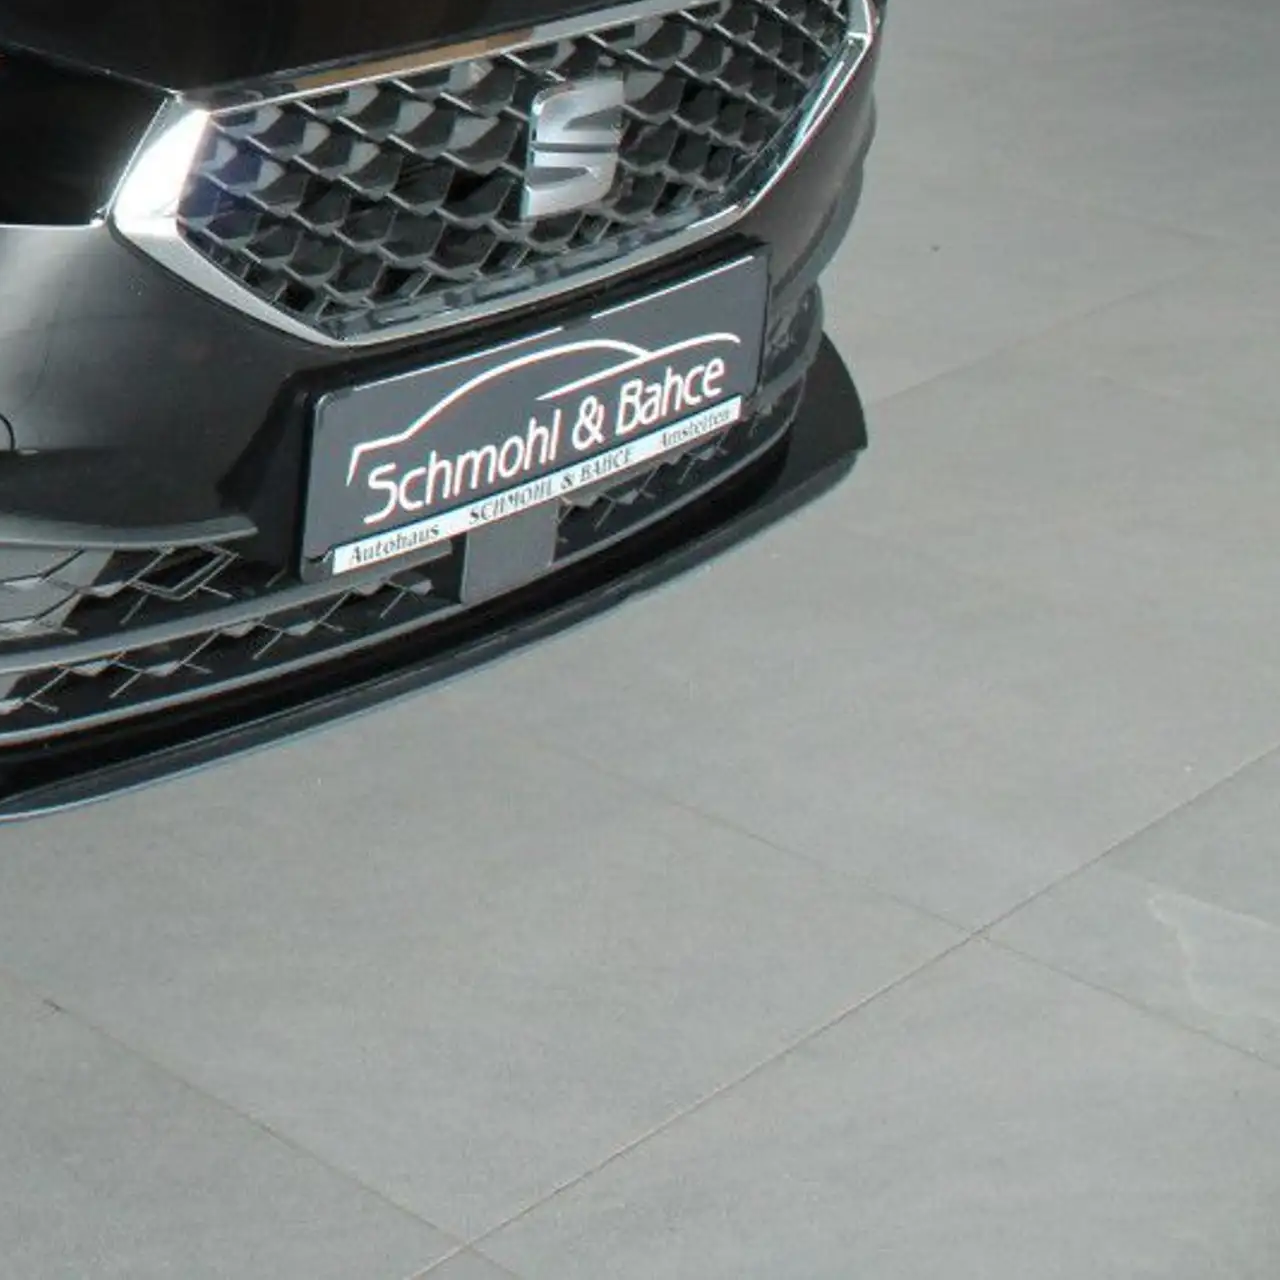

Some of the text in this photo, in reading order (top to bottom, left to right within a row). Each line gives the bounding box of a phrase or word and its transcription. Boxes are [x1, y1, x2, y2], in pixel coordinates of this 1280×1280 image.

[363, 357, 725, 525] Schmohl & Bahce
[351, 524, 439, 563] Autohaus
[468, 480, 552, 524] SCHMOHL
[560, 473, 575, 490] &
